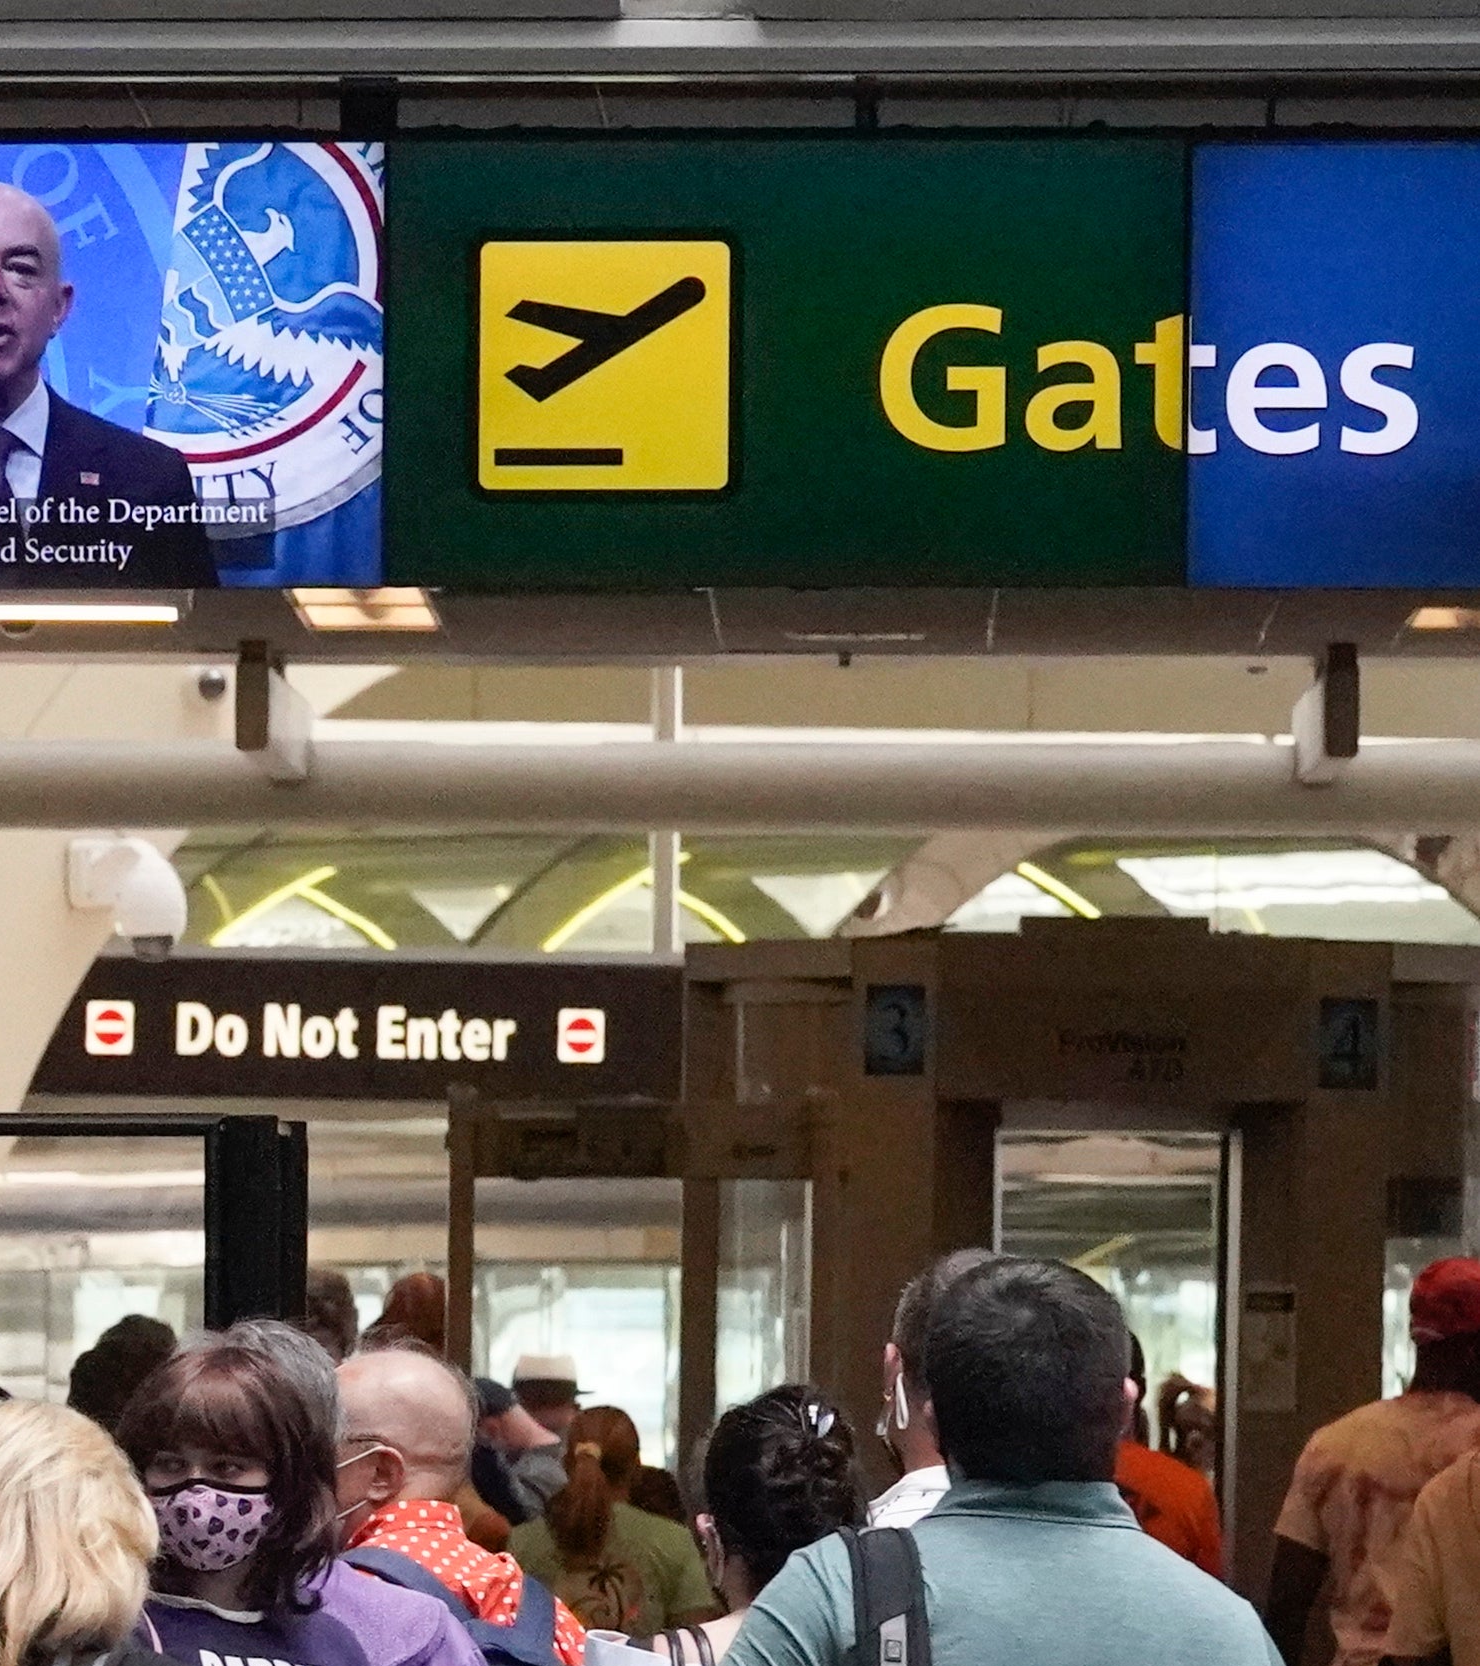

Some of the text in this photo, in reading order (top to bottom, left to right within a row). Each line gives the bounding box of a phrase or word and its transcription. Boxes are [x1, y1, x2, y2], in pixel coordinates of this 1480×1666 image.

[880, 304, 1418, 454] Gates
[25, 498, 54, 524] of
[59, 499, 101, 524] the
[108, 499, 267, 531] Department
[25, 537, 134, 571] Security
[176, 1002, 516, 1061] Do Not Enter
